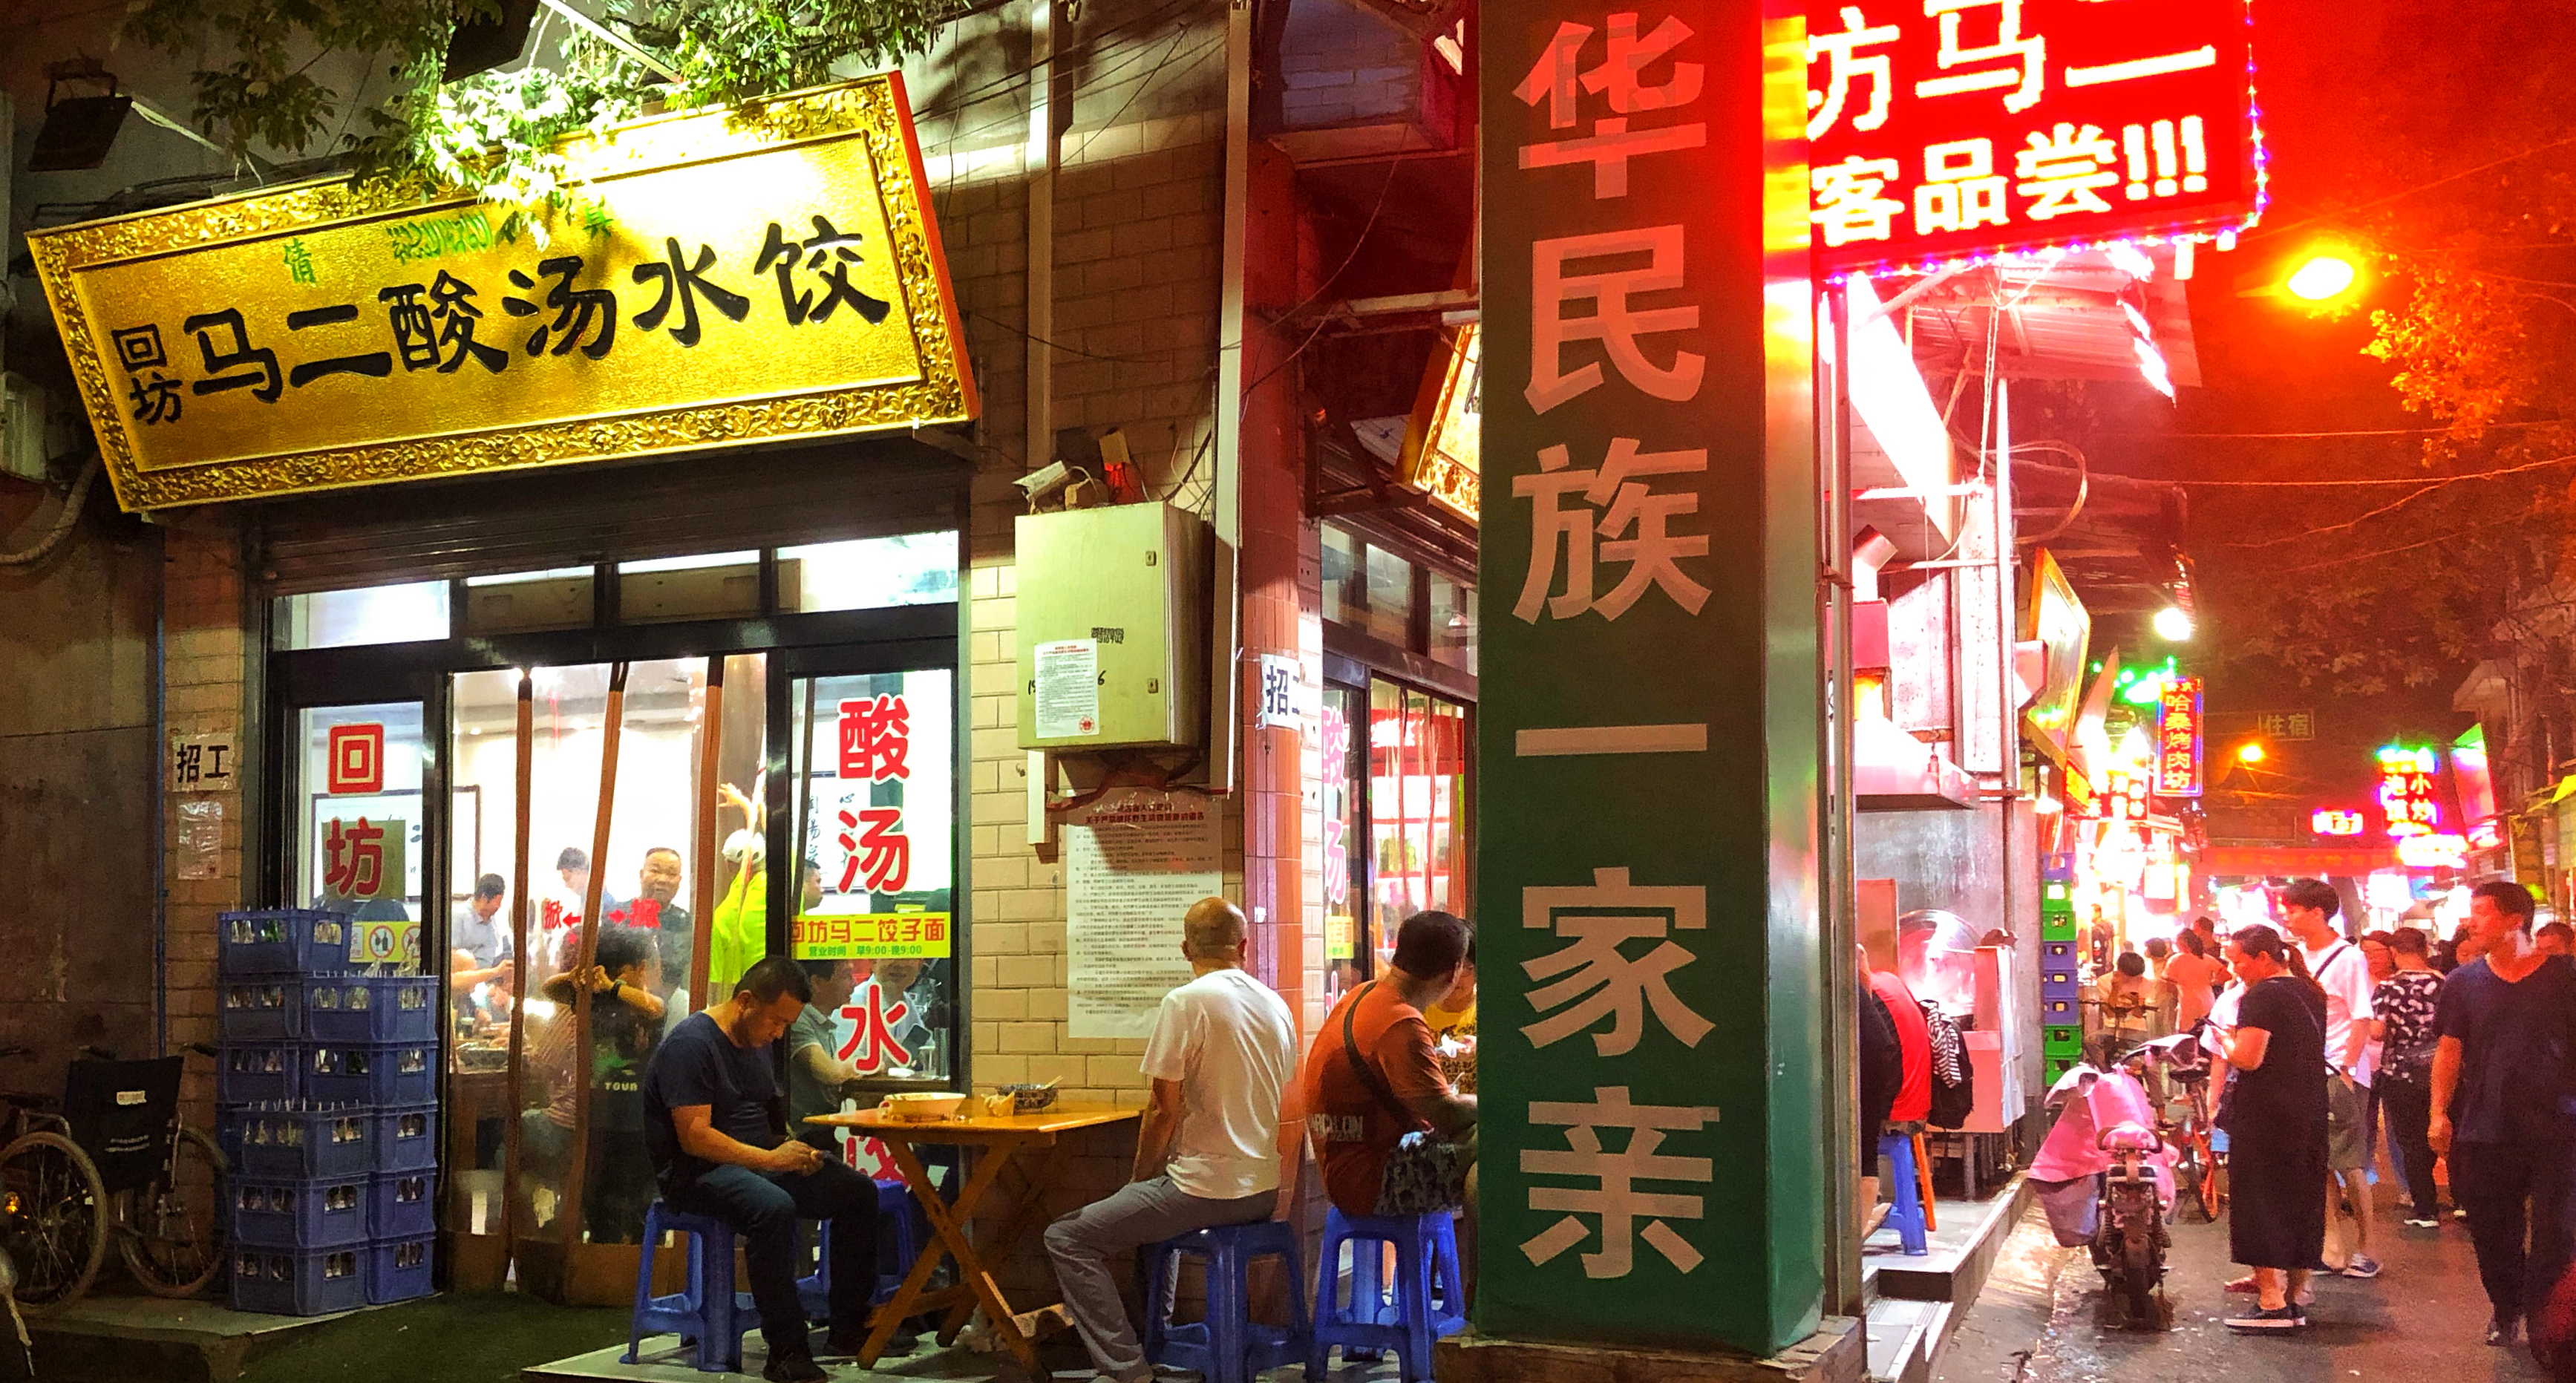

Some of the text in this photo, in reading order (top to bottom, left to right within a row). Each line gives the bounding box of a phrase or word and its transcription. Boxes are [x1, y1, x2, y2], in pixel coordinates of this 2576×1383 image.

[183, 215, 891, 405] 马二酸汤水饺
[111, 324, 184, 425] 回坊
[1512, 11, 1721, 1281] 华民族一家亲
[177, 743, 231, 783] 招工
[2164, 694, 2192, 789] 哈桑烤肉坊
[2265, 713, 2309, 738] 住宿
[324, 723, 385, 895] 回坊
[791, 918, 945, 944] 回坊马二饺子面
